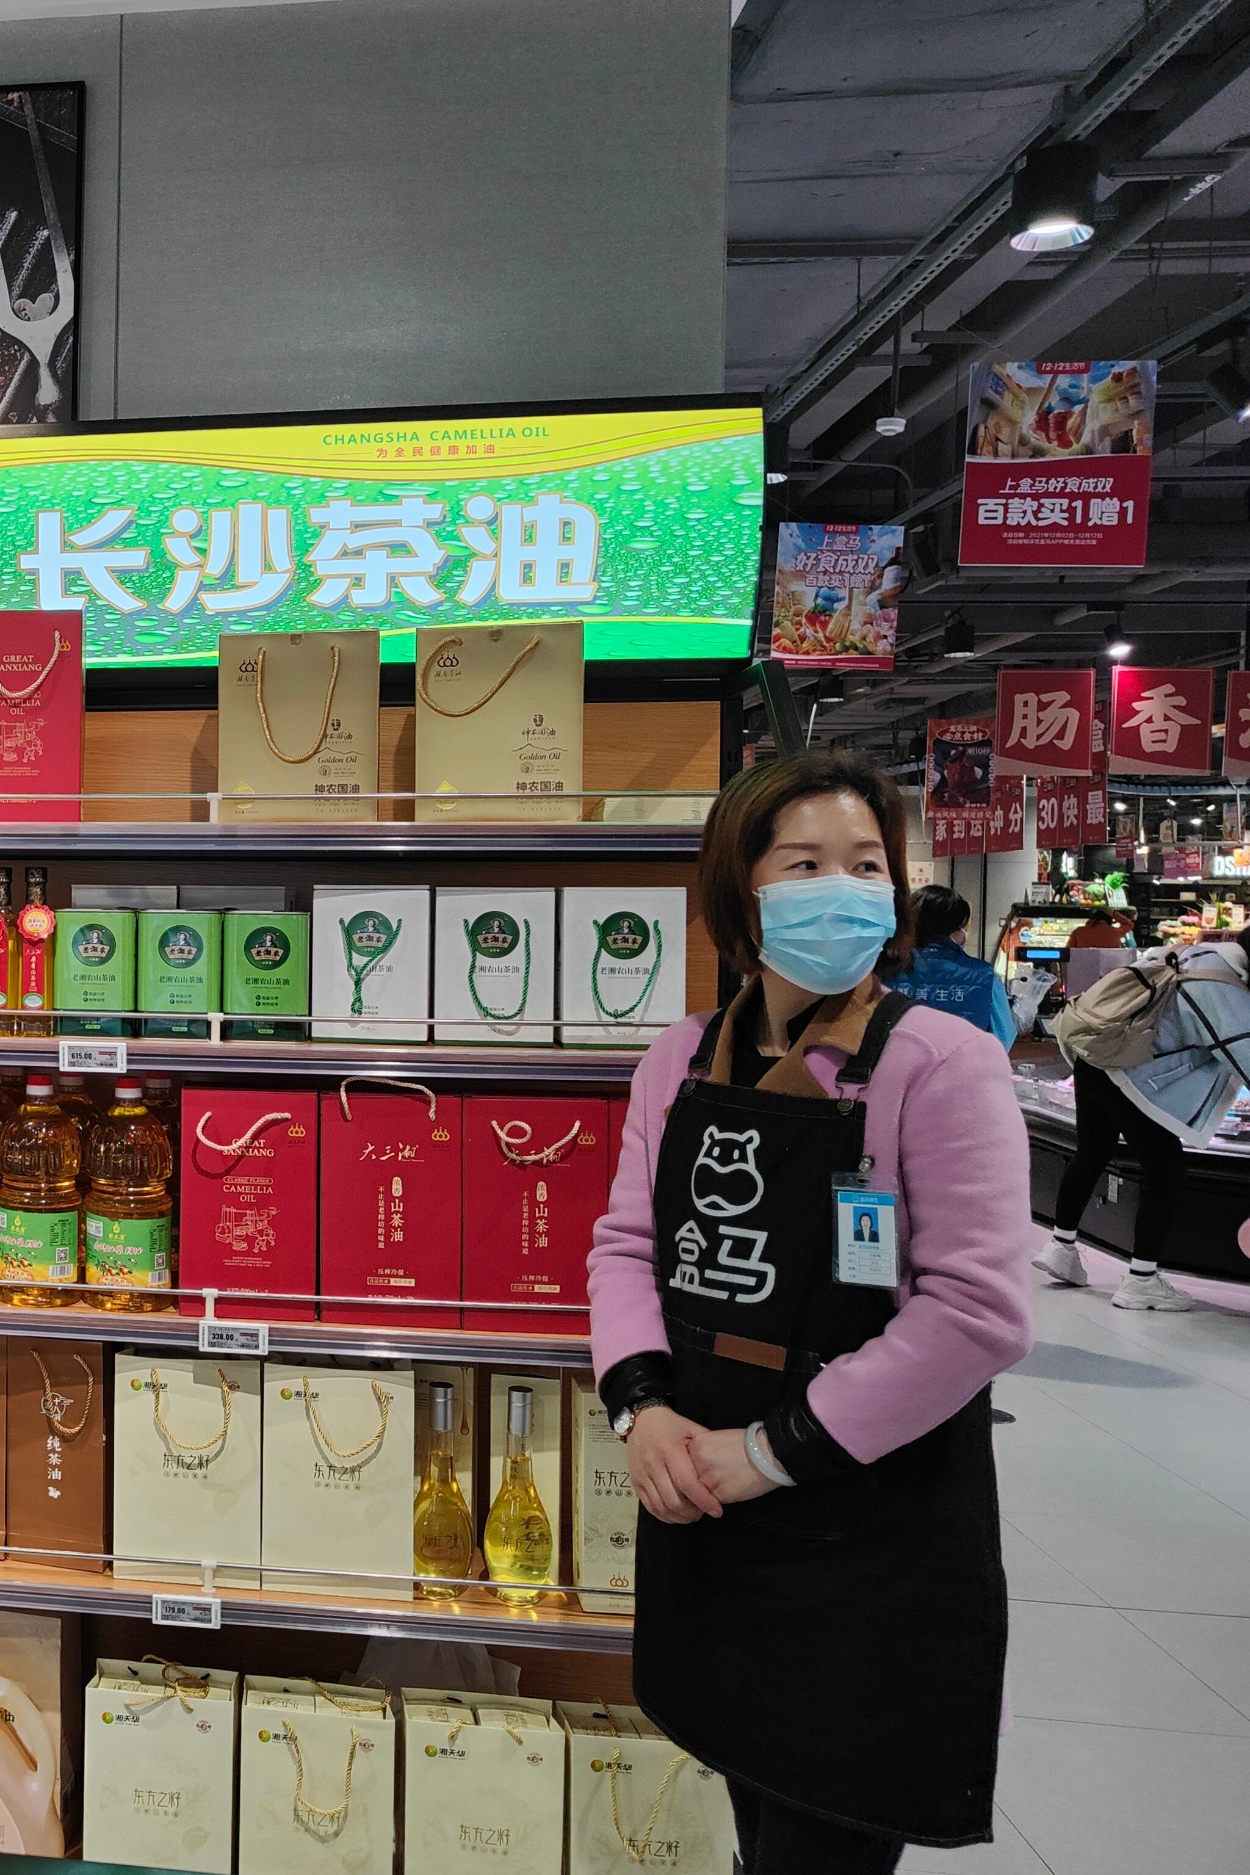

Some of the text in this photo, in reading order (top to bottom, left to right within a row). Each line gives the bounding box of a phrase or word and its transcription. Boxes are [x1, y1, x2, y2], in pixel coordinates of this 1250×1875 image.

[323, 425, 551, 446] CHANGSHA CAMELLIA OIL
[375, 443, 497, 459] 为全民健康加油
[999, 476, 1114, 494] 上盒马好食成双
[976, 497, 1136, 527] 百款买1赠1
[817, 535, 862, 551] 上盒马
[18, 493, 600, 614] 长沙茶油
[795, 551, 879, 574] 好食成双
[2, 655, 35, 663] GREAT
[10, 707, 26, 716] OIL
[1004, 690, 1081, 751] 肠
[1121, 683, 1202, 753] 香
[343, 754, 358, 764] Oil
[548, 752, 562, 760] Oil
[314, 783, 361, 795] 神农国油
[515, 781, 564, 793] 神农国油
[1009, 802, 1023, 834] 分
[1038, 797, 1058, 830] 30
[1062, 794, 1078, 828] 快
[1086, 791, 1105, 825] 最
[71, 1052, 93, 1060] 615.00
[222, 1148, 275, 1158] SANXIANG
[222, 1184, 274, 1194] CAMELLIA
[239, 1194, 257, 1203] OIL
[389, 1198, 405, 1242] 山茶油
[533, 1203, 550, 1248] 山茶油
[669, 1219, 776, 1304] 盒马
[211, 1332, 235, 1342] 338.00
[46, 1435, 63, 1481] 纯茶油
[162, 1452, 211, 1471] 东方之籽
[313, 1462, 363, 1482] 东方之籽
[164, 1606, 186, 1615] 179.00
[133, 1788, 181, 1809] 东方之籽
[459, 1823, 511, 1846] 东方之籽
